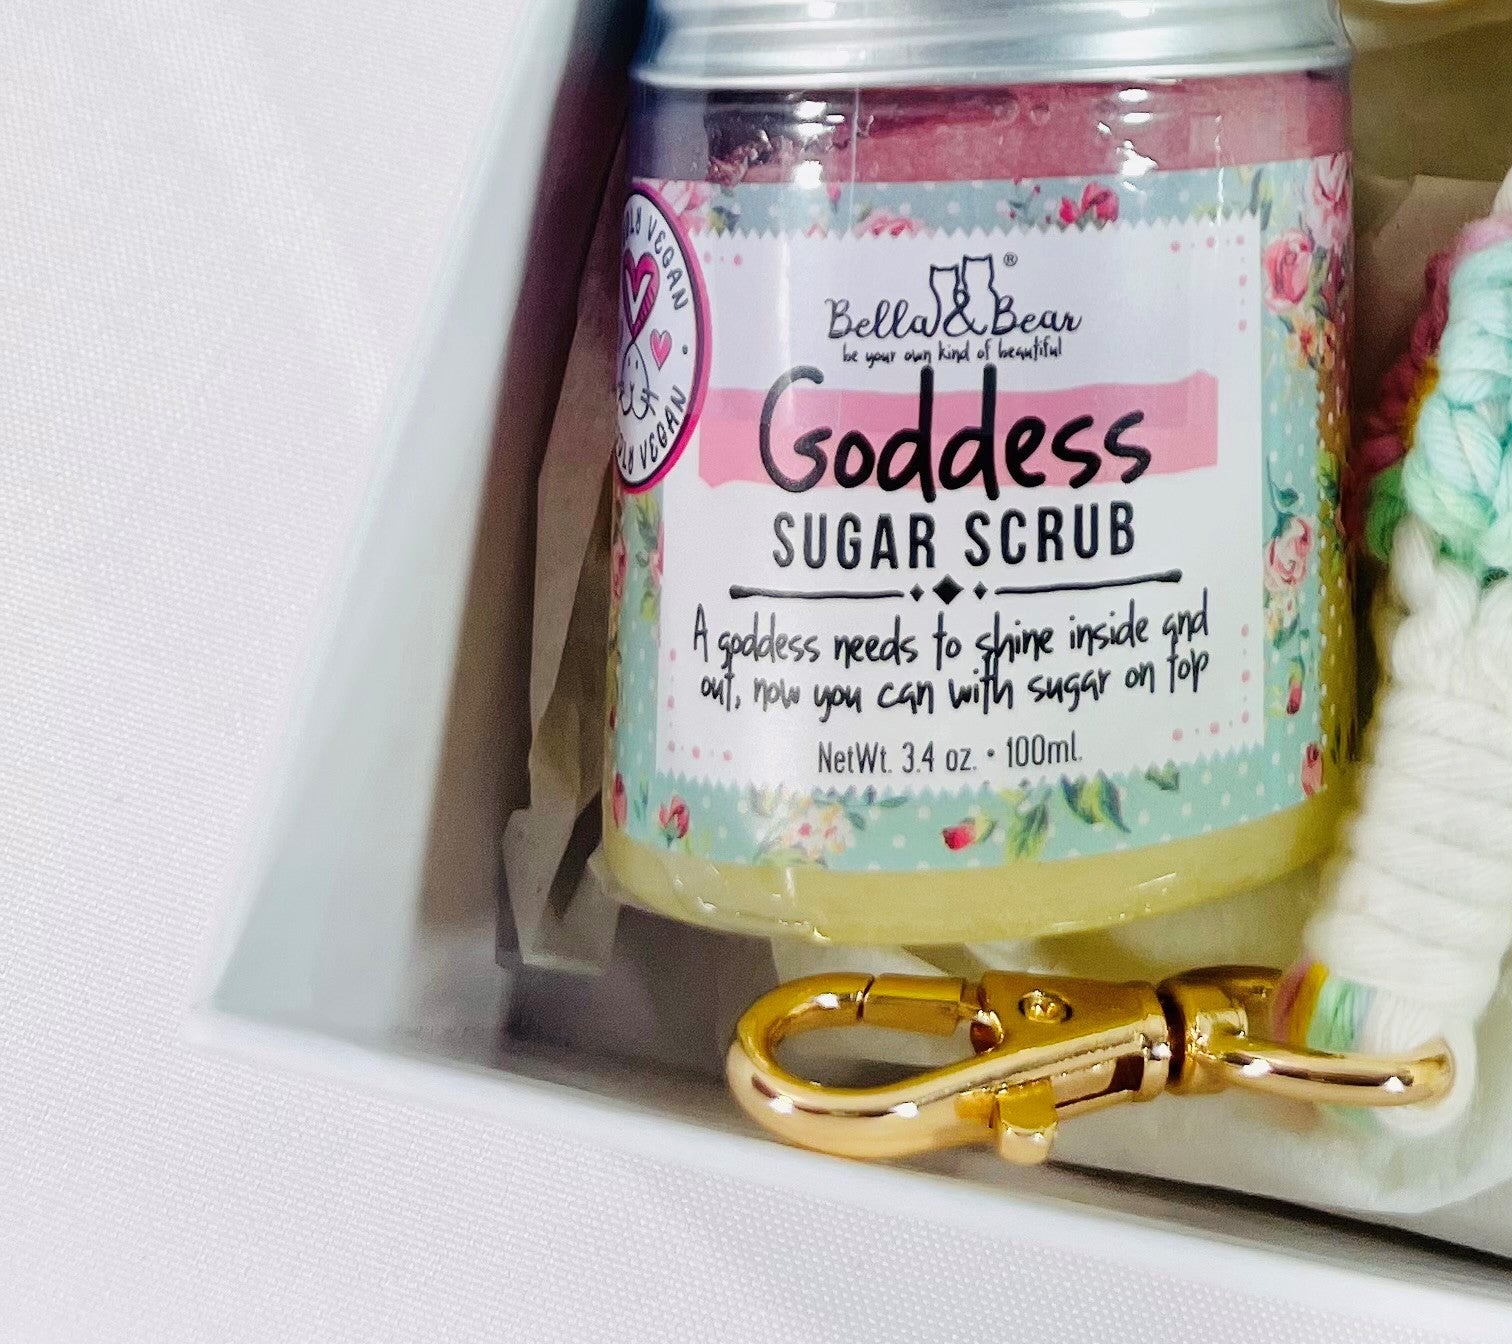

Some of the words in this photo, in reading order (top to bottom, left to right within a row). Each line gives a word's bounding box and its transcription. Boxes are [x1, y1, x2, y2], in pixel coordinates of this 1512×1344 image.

[647, 215, 689, 311] VEGAN
[824, 299, 940, 339] Bella
[992, 295, 1083, 335] Bear
[843, 344, 858, 362] be
[865, 349, 896, 369] your
[904, 349, 932, 363] own
[938, 340, 970, 362] kind
[977, 338, 992, 359] of
[998, 335, 1062, 362] beautiful
[640, 384, 687, 470] VEGAN
[759, 363, 1153, 504] Goddess
[771, 512, 937, 570] SUGAR
[964, 500, 1136, 568] SCRUB
[693, 604, 709, 663] A
[718, 611, 821, 679] goddess
[833, 615, 918, 668] needs
[932, 612, 962, 670] to
[975, 611, 1054, 668] shine
[1070, 599, 1149, 653] inside
[1162, 587, 1208, 653] and
[700, 667, 741, 712] out,
[754, 678, 801, 713] now
[814, 680, 862, 724] you
[877, 677, 935, 714] can
[949, 662, 1014, 714] with
[1029, 669, 1111, 712] sugar
[1125, 663, 1155, 694] on
[1170, 649, 1210, 694] top
[901, 741, 935, 774] 3.4
[945, 746, 978, 772] oz.
